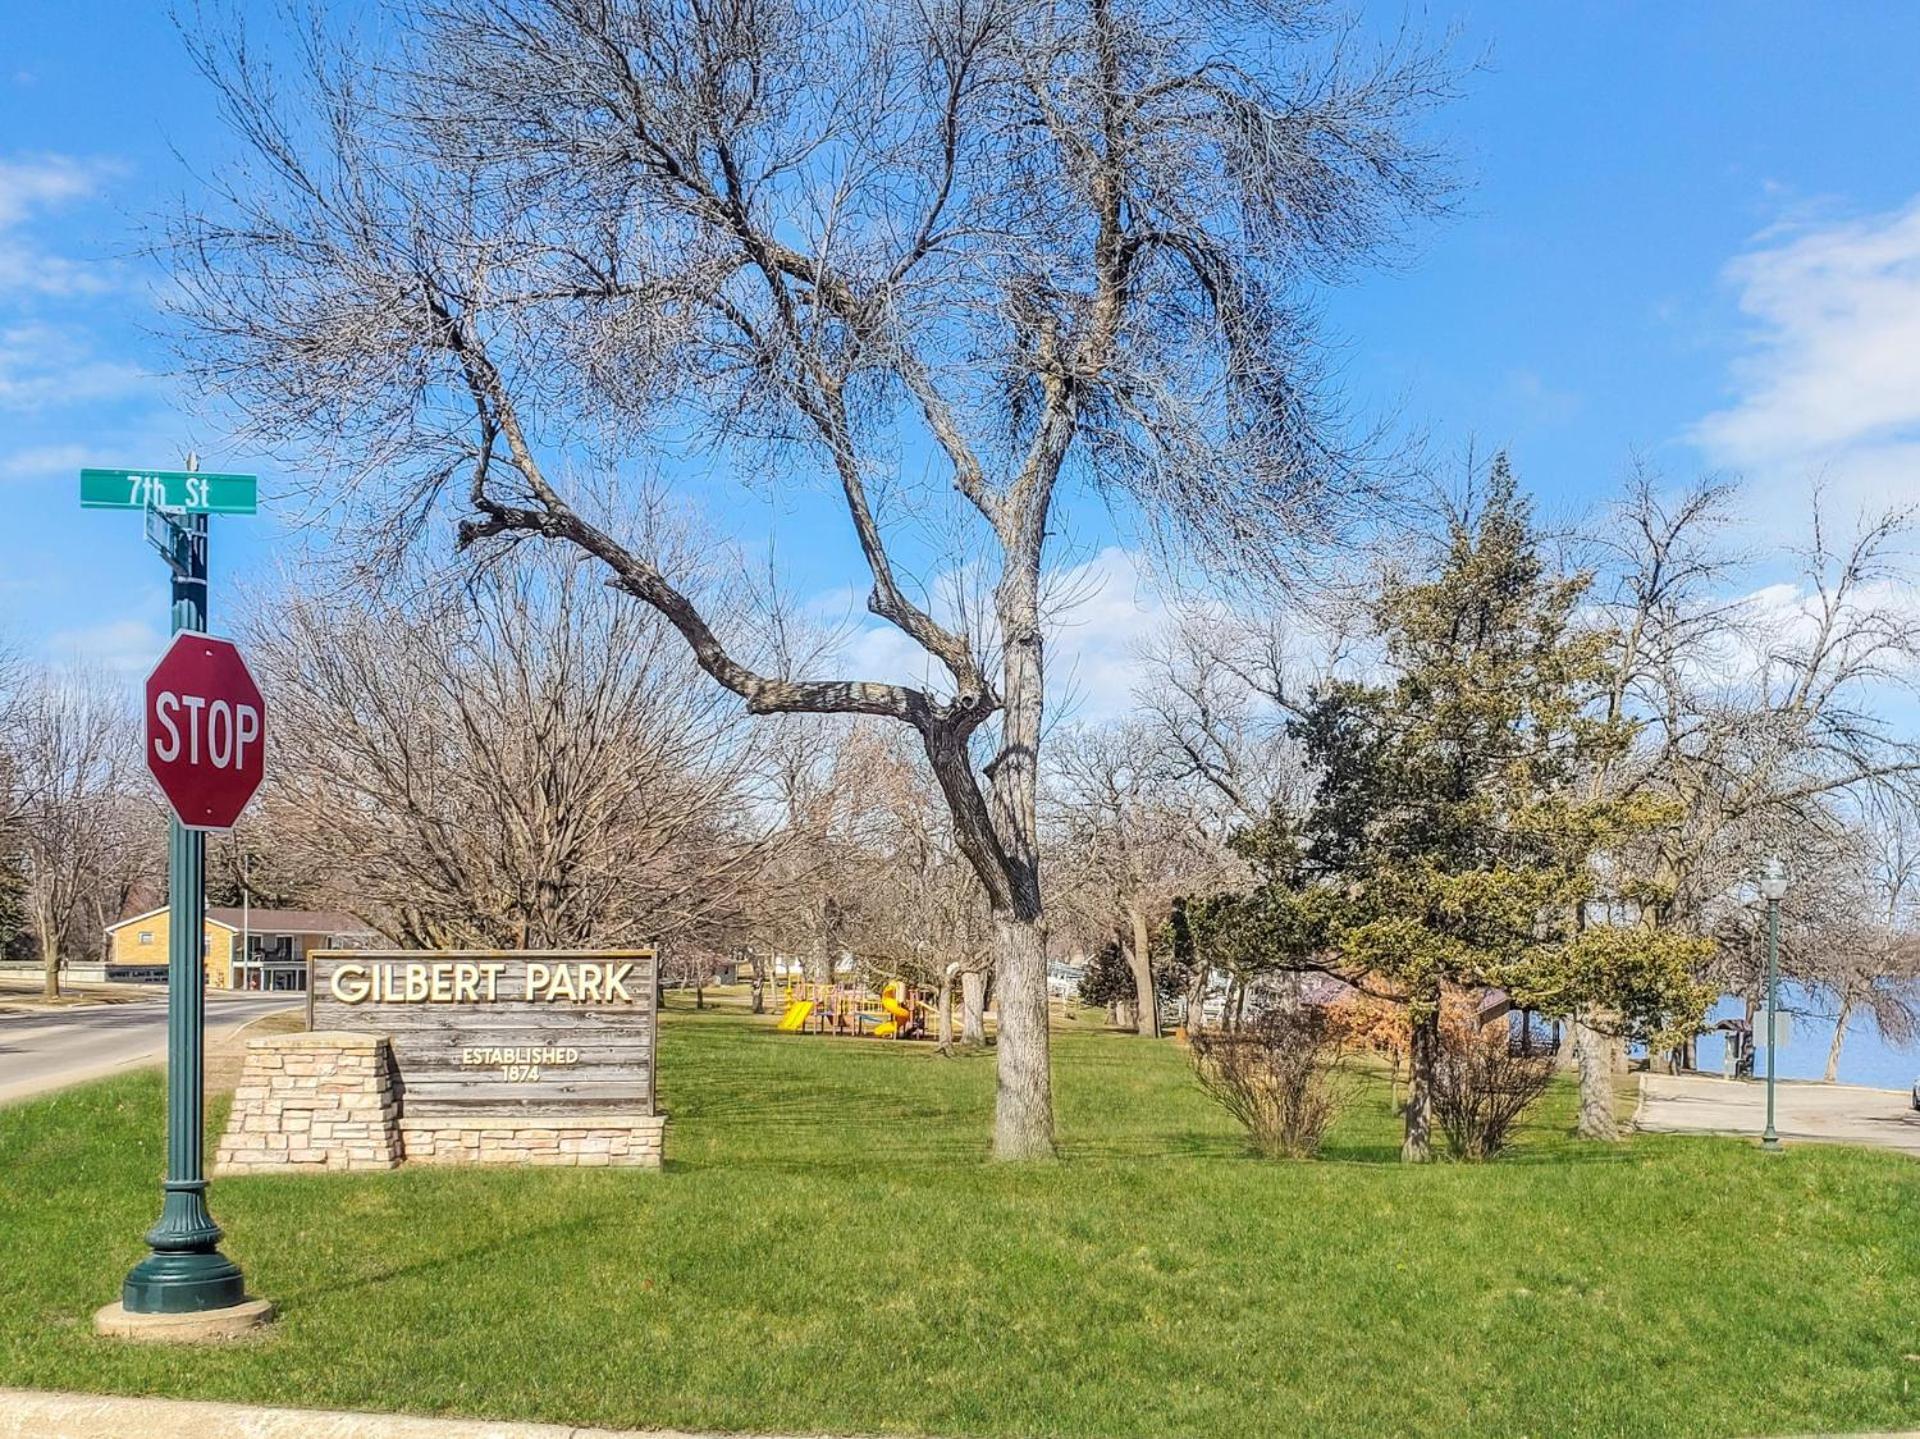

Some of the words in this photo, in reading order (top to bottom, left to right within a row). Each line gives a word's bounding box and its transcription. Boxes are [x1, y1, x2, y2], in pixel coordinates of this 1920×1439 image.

[127, 475, 166, 505] 7th
[185, 477, 210, 508] St
[154, 690, 259, 770] STOP
[330, 963, 507, 1003] GILBERT
[526, 963, 634, 1003] PARK
[462, 1047, 578, 1065] ESTABLISHED
[501, 1065, 540, 1082] 1874
